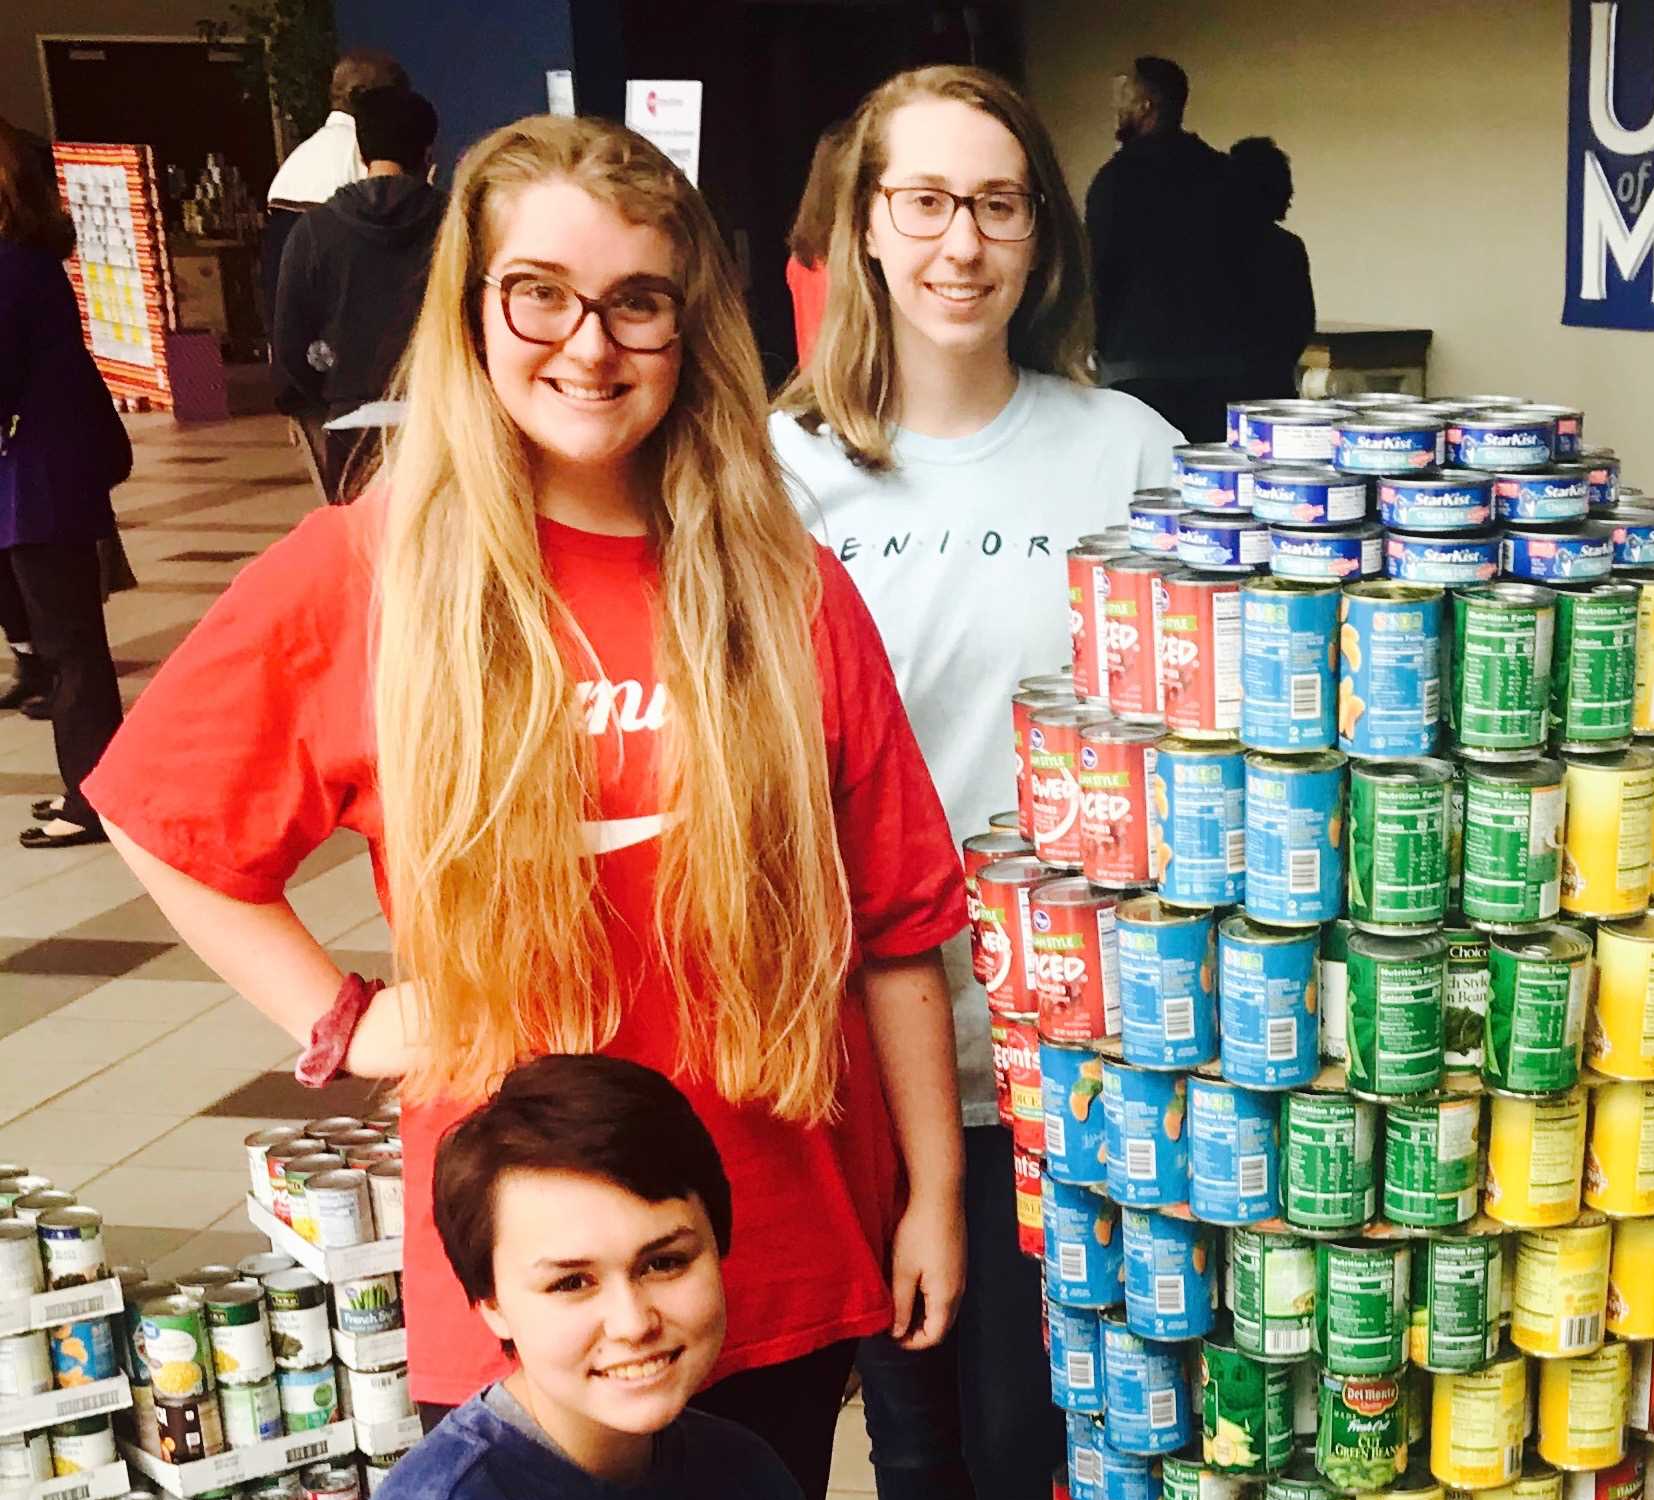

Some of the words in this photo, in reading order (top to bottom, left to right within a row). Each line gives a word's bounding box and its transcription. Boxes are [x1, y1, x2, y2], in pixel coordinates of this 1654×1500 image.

[1616, 160, 1652, 213] of
[1357, 435, 1412, 450] StarKist
[1483, 432, 1538, 447] StarKist
[1414, 492, 1471, 506] StarKist
[1280, 541, 1332, 557] StarKist
[1423, 548, 1480, 563] StarKist
[1347, 1387, 1363, 1400] Del
[1364, 1386, 1396, 1400] Monte
